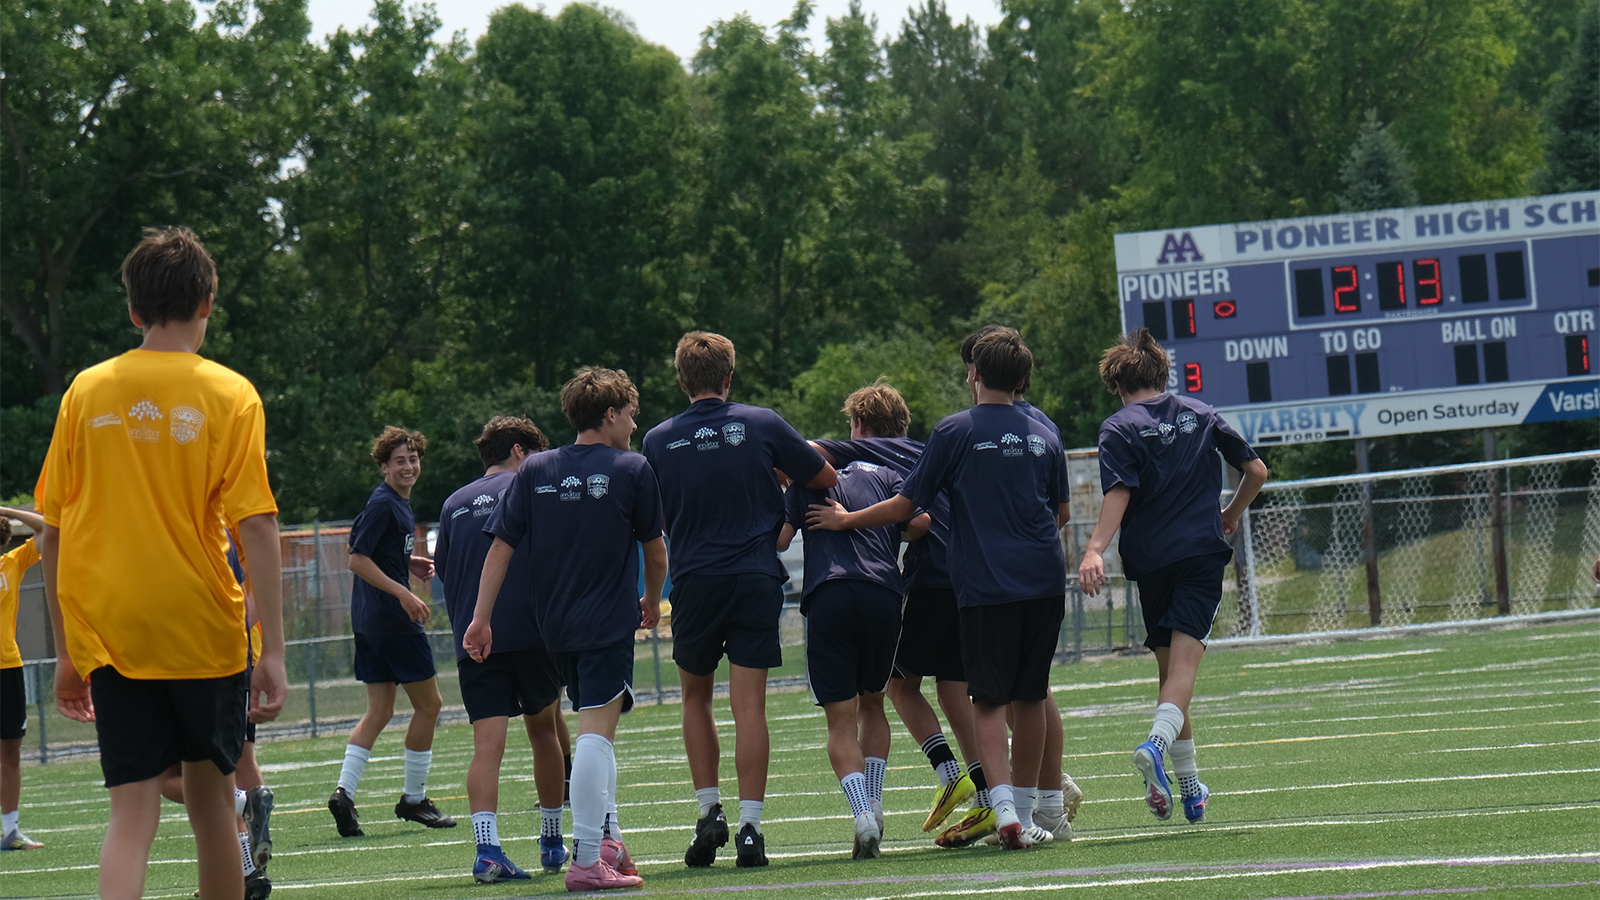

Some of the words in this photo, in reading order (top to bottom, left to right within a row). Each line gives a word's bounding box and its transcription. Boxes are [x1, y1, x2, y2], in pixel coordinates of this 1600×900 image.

[1235, 217, 1400, 254] PIONEER
[1414, 208, 1511, 238] HIGH
[1523, 200, 1597, 229] SCH
[1123, 268, 1231, 302] PIONEER
[1334, 259, 1442, 312] 2:13
[1188, 302, 1196, 334] 1
[1441, 319, 1487, 344] BALL
[1490, 316, 1517, 339] ON
[1553, 310, 1595, 334] QTR
[1225, 336, 1289, 362] DOWN
[1320, 330, 1348, 353] TO
[1353, 327, 1382, 351] GO
[1581, 338, 1589, 370] 1
[1186, 362, 1202, 392] 3
[1377, 408, 1428, 426] Open
[1433, 400, 1520, 420] Saturday
[1548, 388, 1600, 413] Varsi
[1237, 403, 1367, 444] VARSITY
[1284, 431, 1323, 443] FORD
